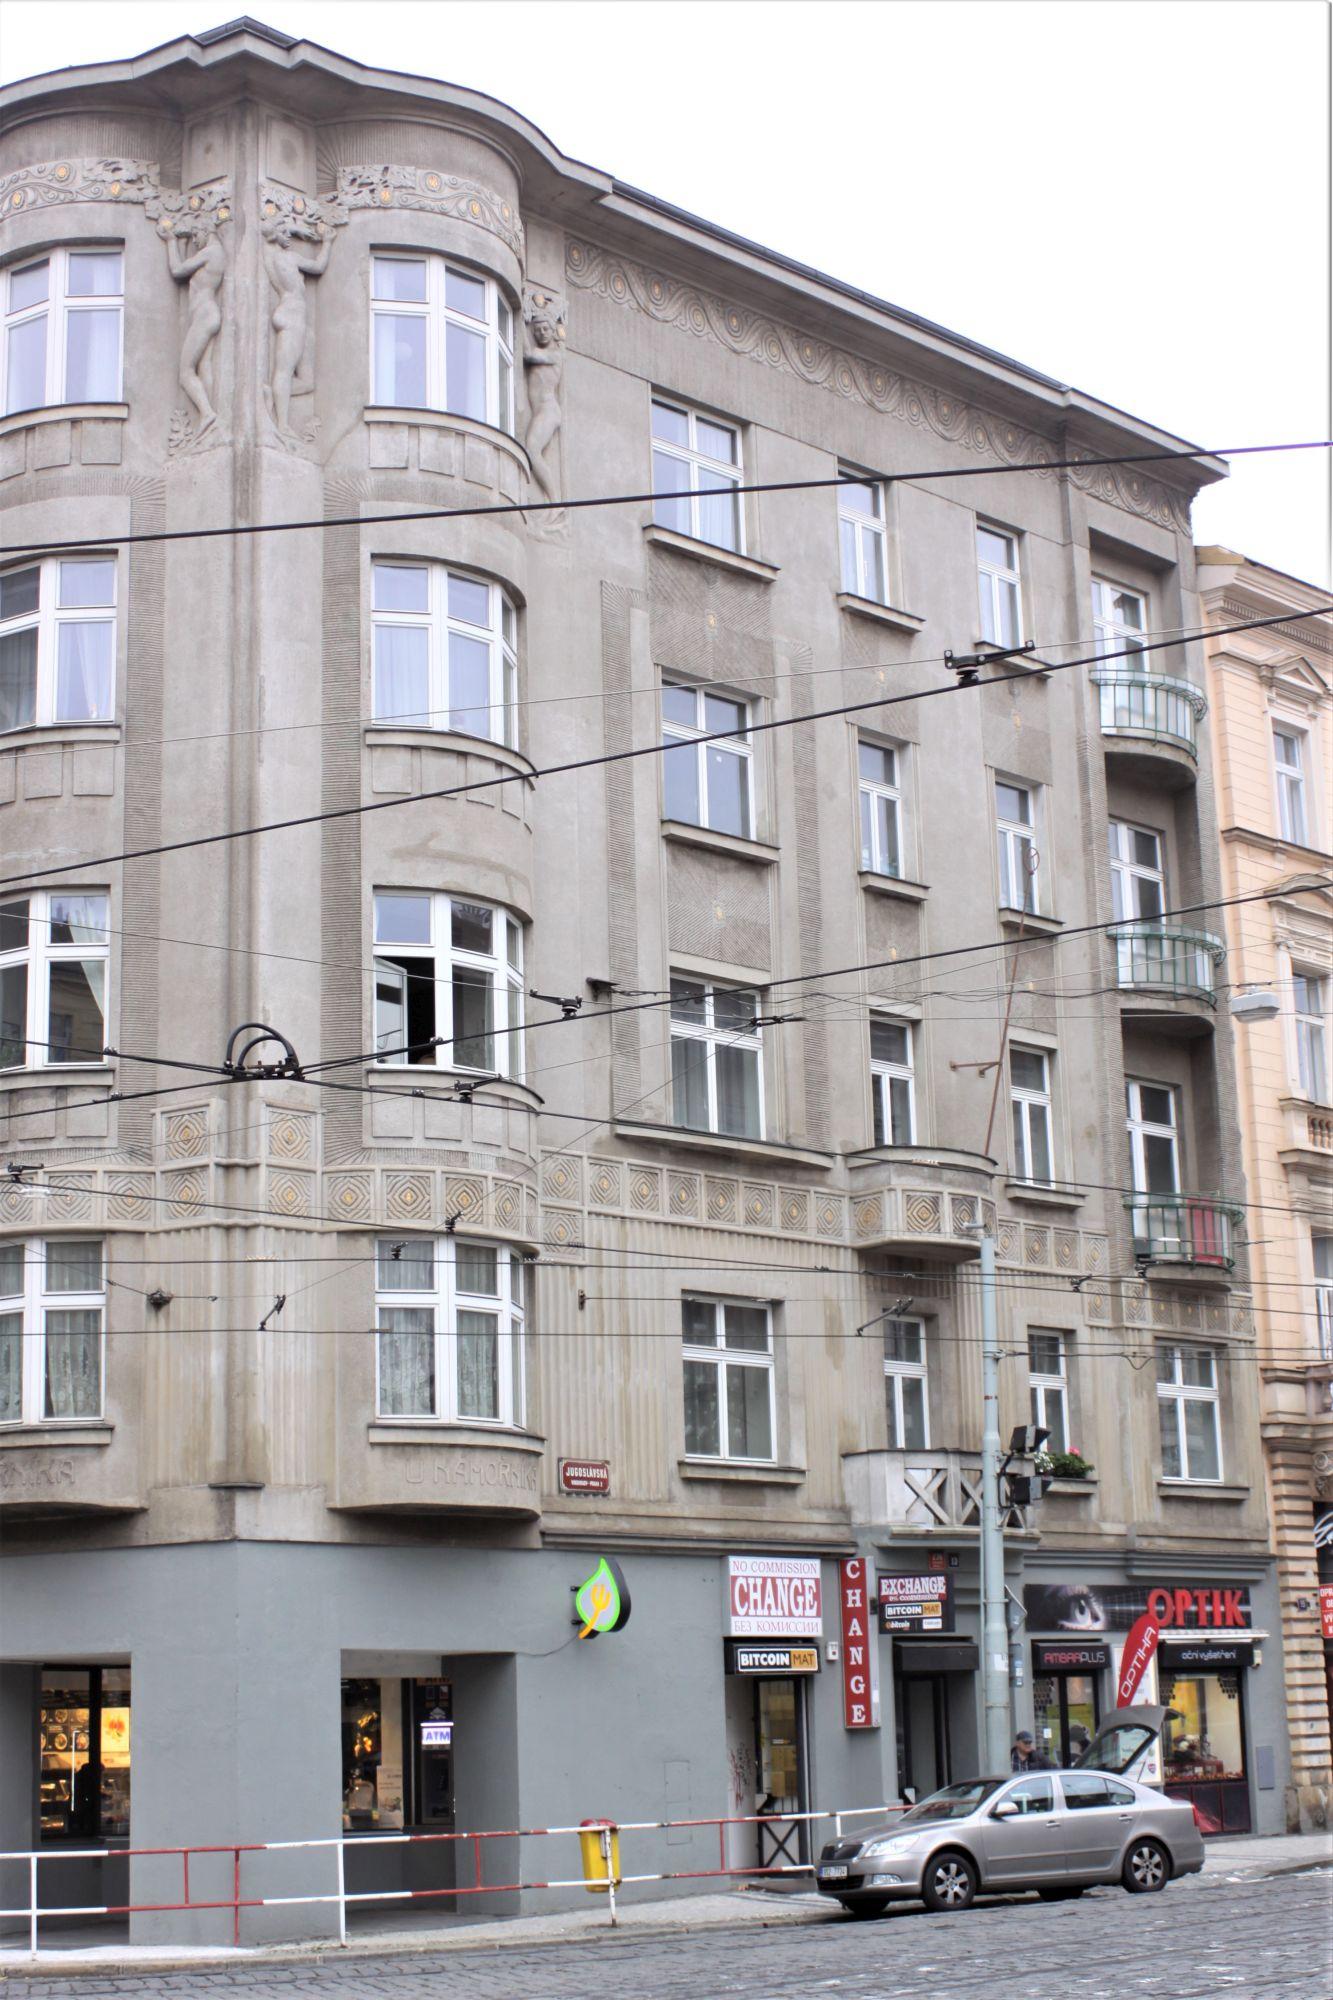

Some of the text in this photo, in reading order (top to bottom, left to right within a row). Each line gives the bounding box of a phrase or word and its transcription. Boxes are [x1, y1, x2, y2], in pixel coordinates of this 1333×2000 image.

[566, 1467, 608, 1479] JUGOSLÁVSKÁ
[733, 1560, 817, 1574] NO COMMISSION
[881, 1576, 946, 1595] EXCHANGE
[734, 1577, 818, 1617] CHANGE
[887, 1606, 922, 1615] BITCOIN
[1147, 1588, 1246, 1628] OPTIK
[734, 1620, 819, 1634] БЕЗ КОМИССИИ
[846, 1560, 866, 1723] CHANGE
[741, 1653, 814, 1666] BITCOIN MAT
[426, 1730, 450, 1741] ATM
